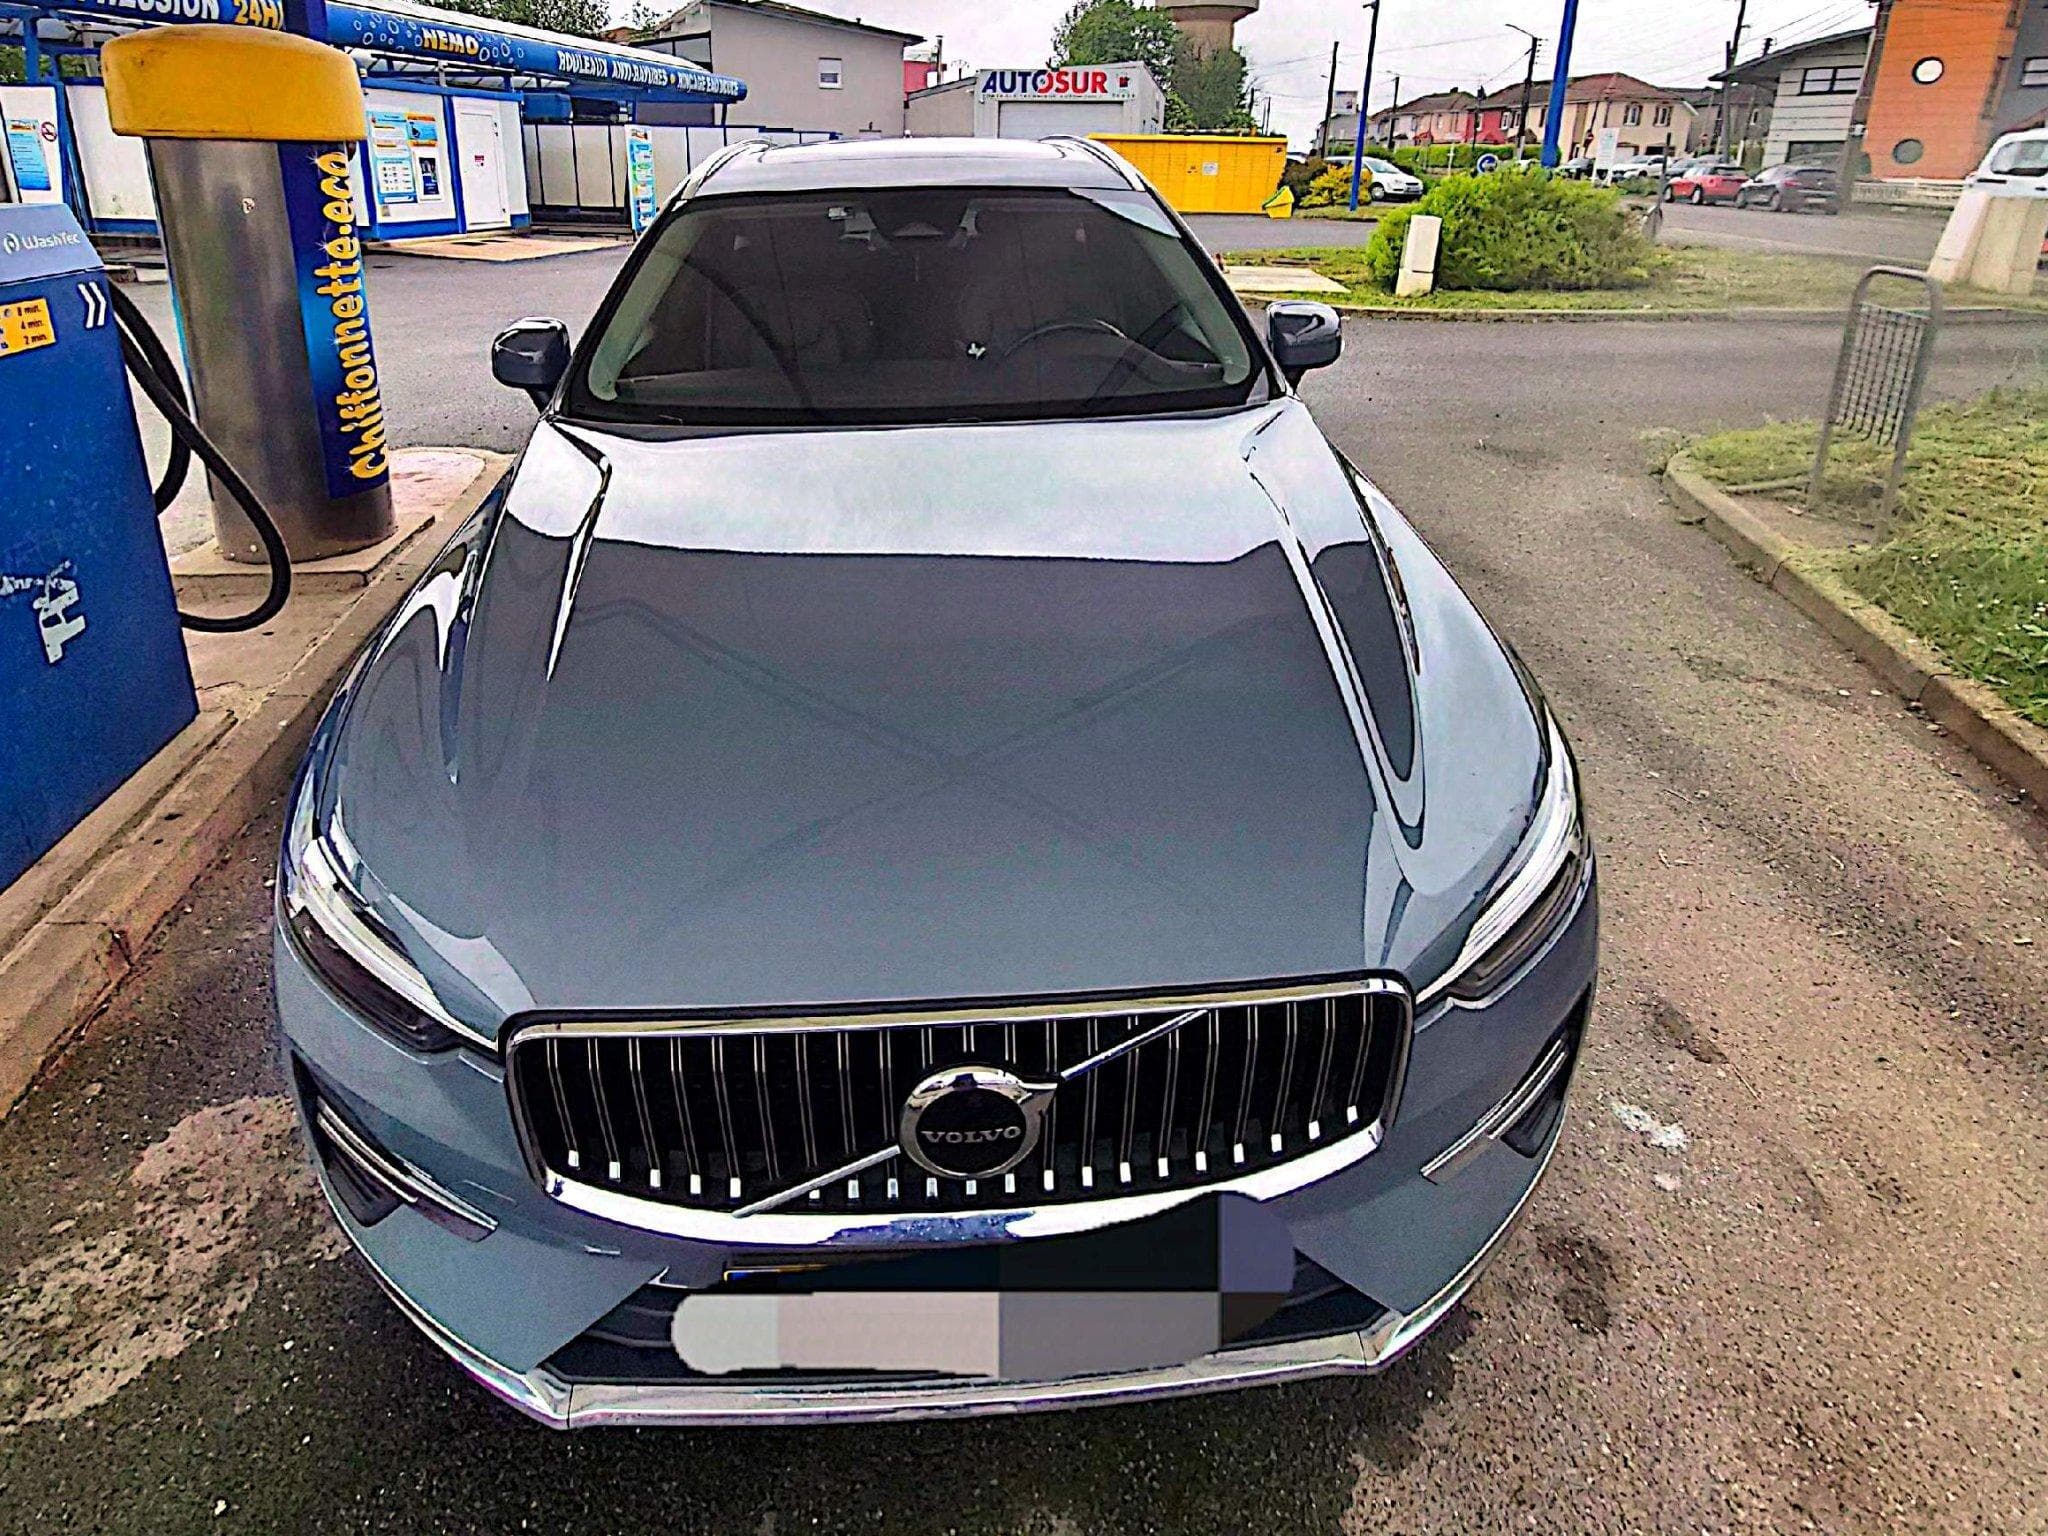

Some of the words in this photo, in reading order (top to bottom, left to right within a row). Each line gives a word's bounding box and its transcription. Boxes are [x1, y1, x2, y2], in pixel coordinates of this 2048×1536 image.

[421, 27, 479, 55] NEMO
[557, 50, 608, 77] ROULEAUX
[612, 61, 668, 86] ANTI-RAYURES
[981, 69, 1108, 94] AUTOSUR
[21, 231, 80, 250] WashTec
[921, 1126, 1021, 1144] VOLVO
